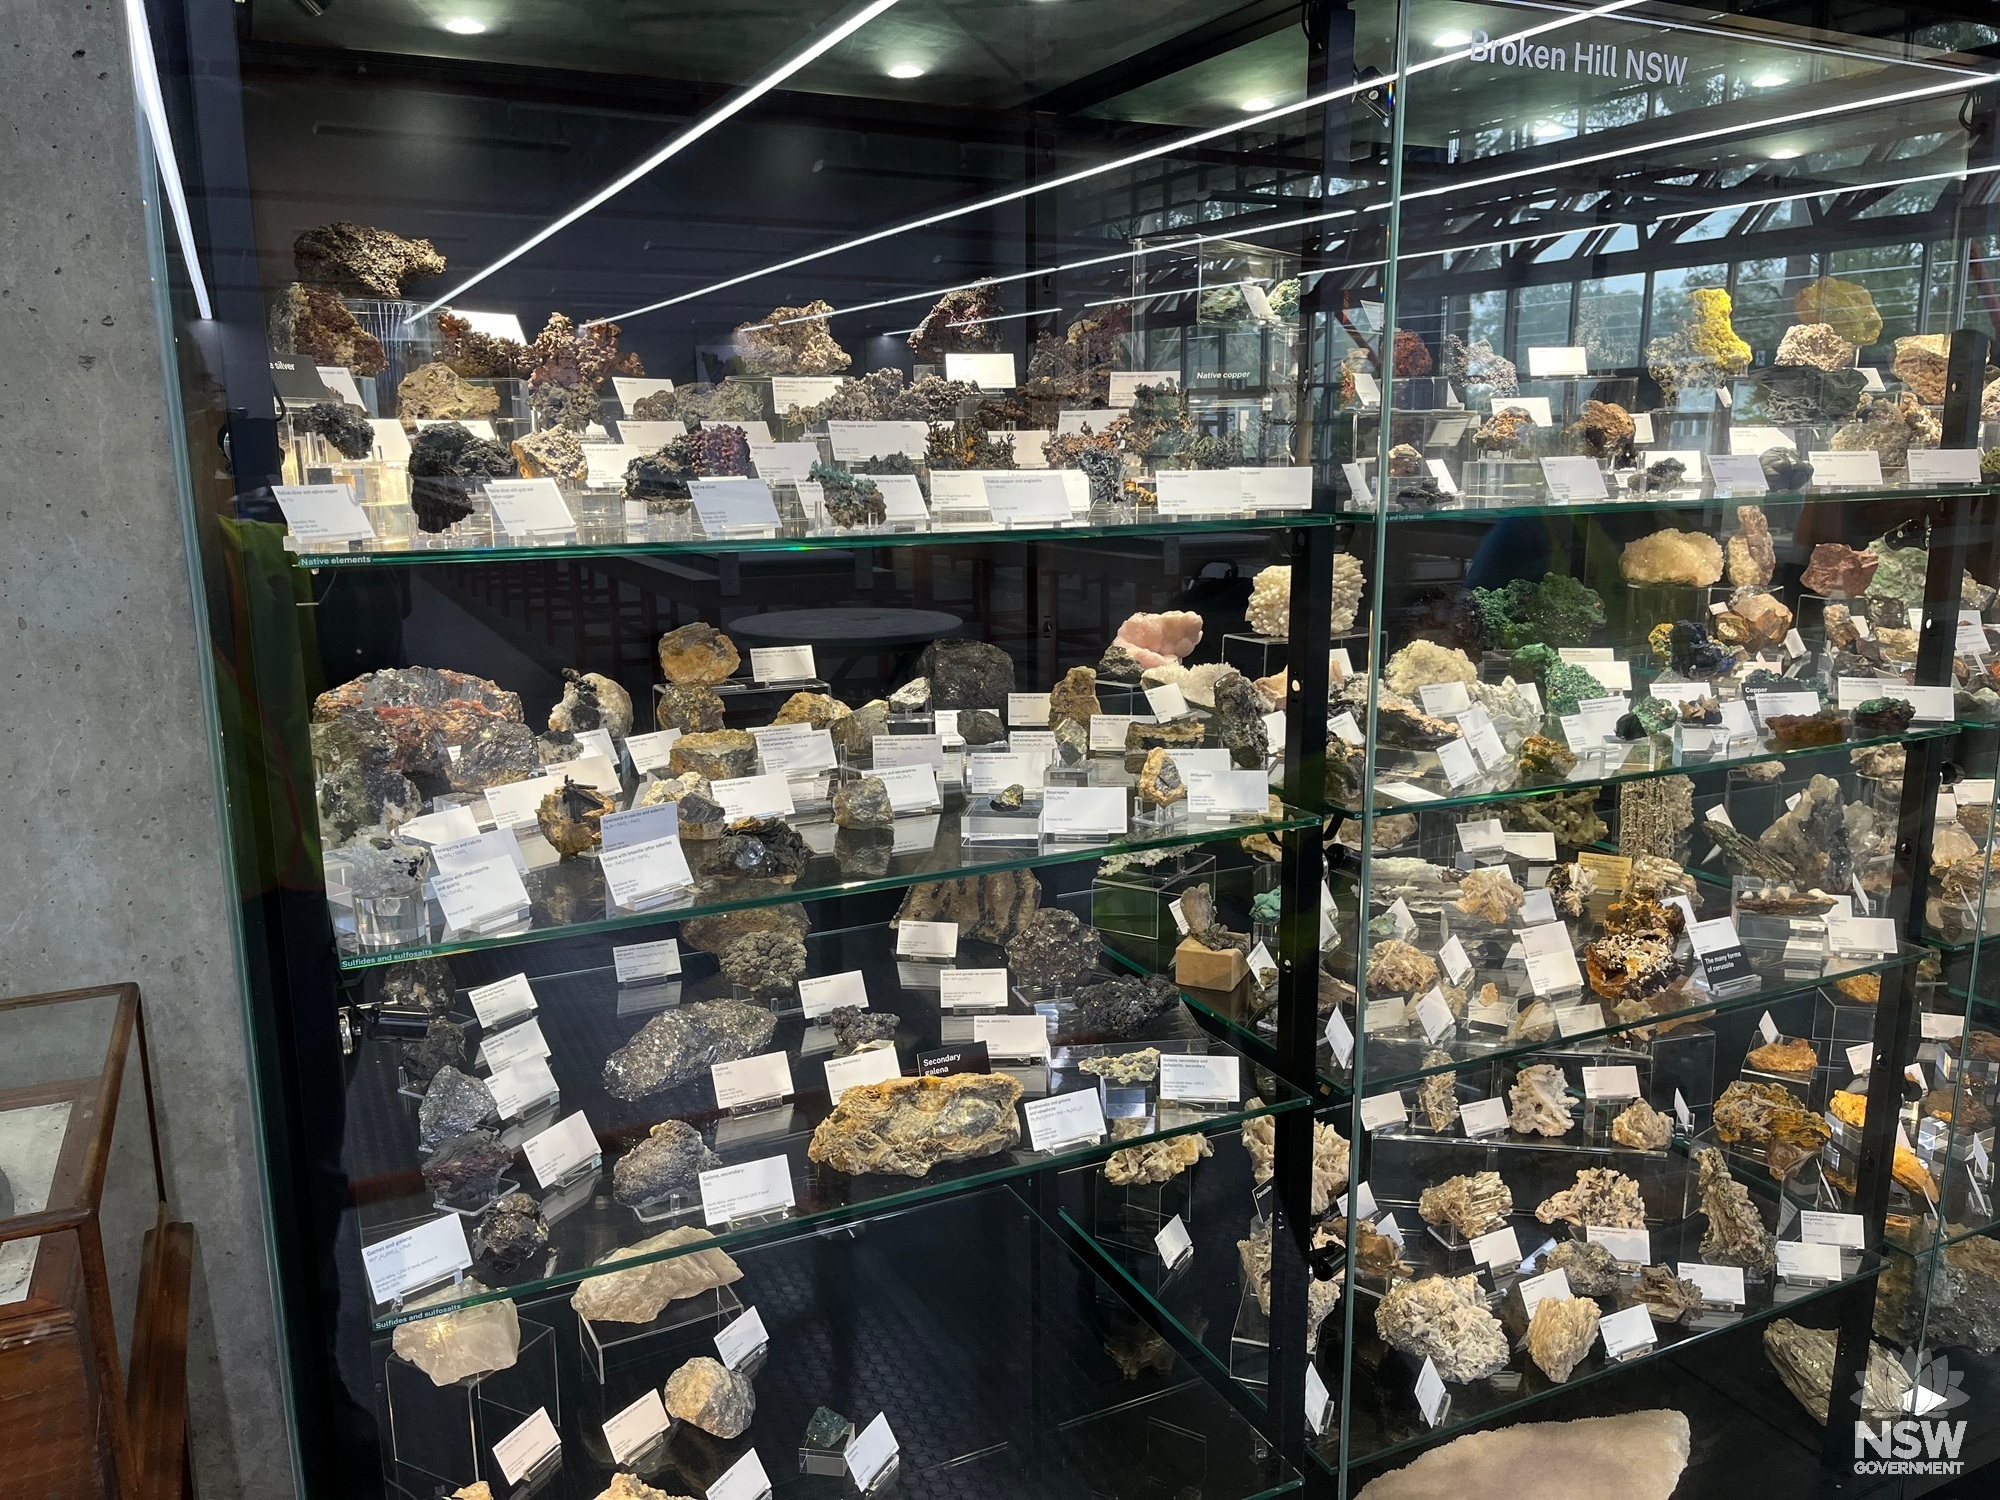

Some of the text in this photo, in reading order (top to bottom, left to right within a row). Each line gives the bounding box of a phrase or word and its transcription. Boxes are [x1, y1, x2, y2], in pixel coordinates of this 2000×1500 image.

[1471, 28, 1688, 85] Broken Hill NSW
[274, 361, 295, 371] silver
[1196, 371, 1251, 380] Native copper
[301, 556, 371, 566] Native elements
[603, 815, 624, 825] Dyscrasite
[435, 844, 459, 854] Pyrargyrite
[434, 876, 454, 886] Covellite
[463, 866, 490, 876] chalcopyrite
[342, 949, 433, 968] Sulfides and sulfosalts
[1704, 951, 1742, 965] The many forms
[1707, 962, 1735, 974] of cerussite
[923, 1053, 961, 1076] Secondary galena
[720, 1168, 745, 1178] secondary
[366, 1235, 413, 1257] Garnet and galena
[375, 1303, 461, 1329] Sulfides and sulfosalts
